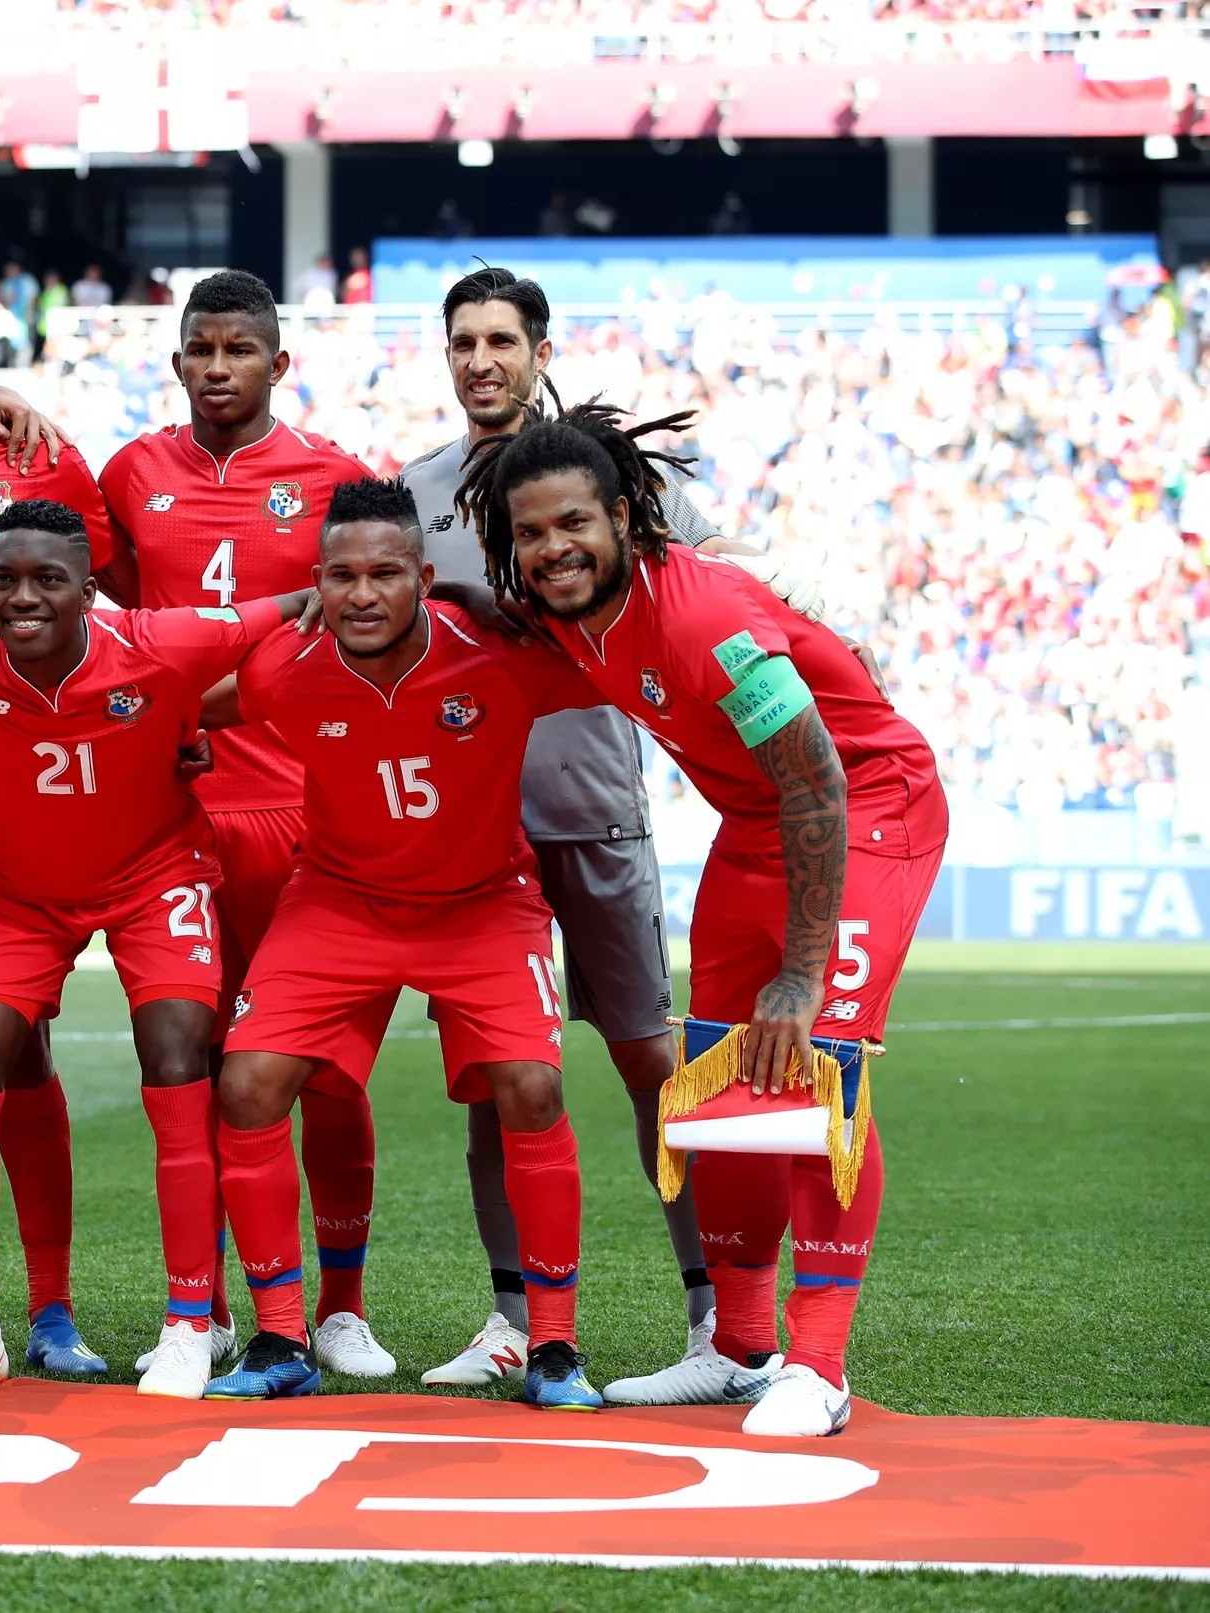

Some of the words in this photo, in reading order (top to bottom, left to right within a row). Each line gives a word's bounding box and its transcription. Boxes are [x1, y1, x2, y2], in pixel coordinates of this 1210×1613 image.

[201, 539, 236, 607] 4
[732, 689, 775, 723] OTBALL
[760, 702, 788, 726] FIFA
[32, 741, 97, 795] 21
[377, 755, 440, 819] 15
[160, 882, 212, 941] 21
[1010, 868, 1204, 938] FIFA
[652, 912, 670, 979] 1
[831, 920, 870, 991] 5
[528, 1254, 581, 1274] PANA
